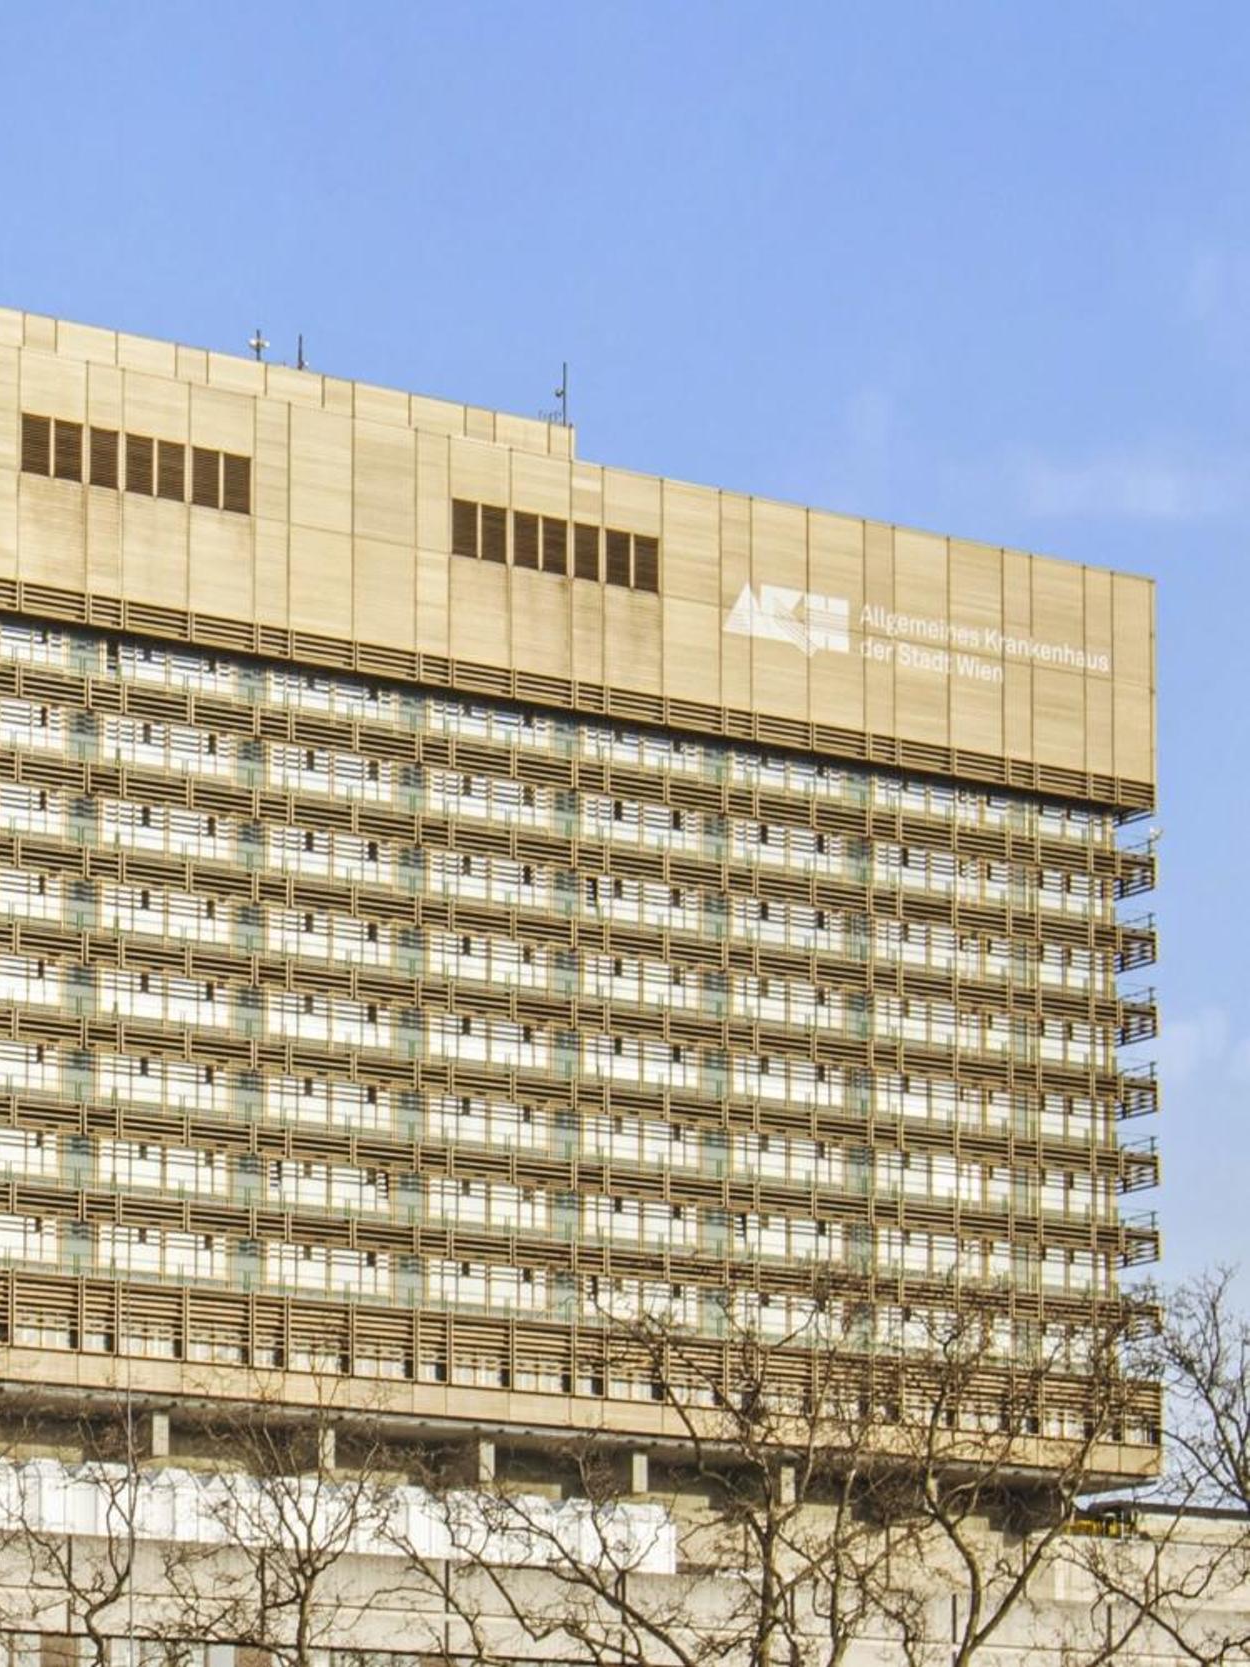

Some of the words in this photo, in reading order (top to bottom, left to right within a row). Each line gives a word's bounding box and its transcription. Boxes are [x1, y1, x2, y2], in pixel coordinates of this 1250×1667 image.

[860, 604, 980, 647] Allgemeines
[984, 628, 1110, 672] Krankenhaus
[860, 637, 893, 664] der
[897, 642, 950, 673] Stadt
[956, 654, 1003, 682] Wien
